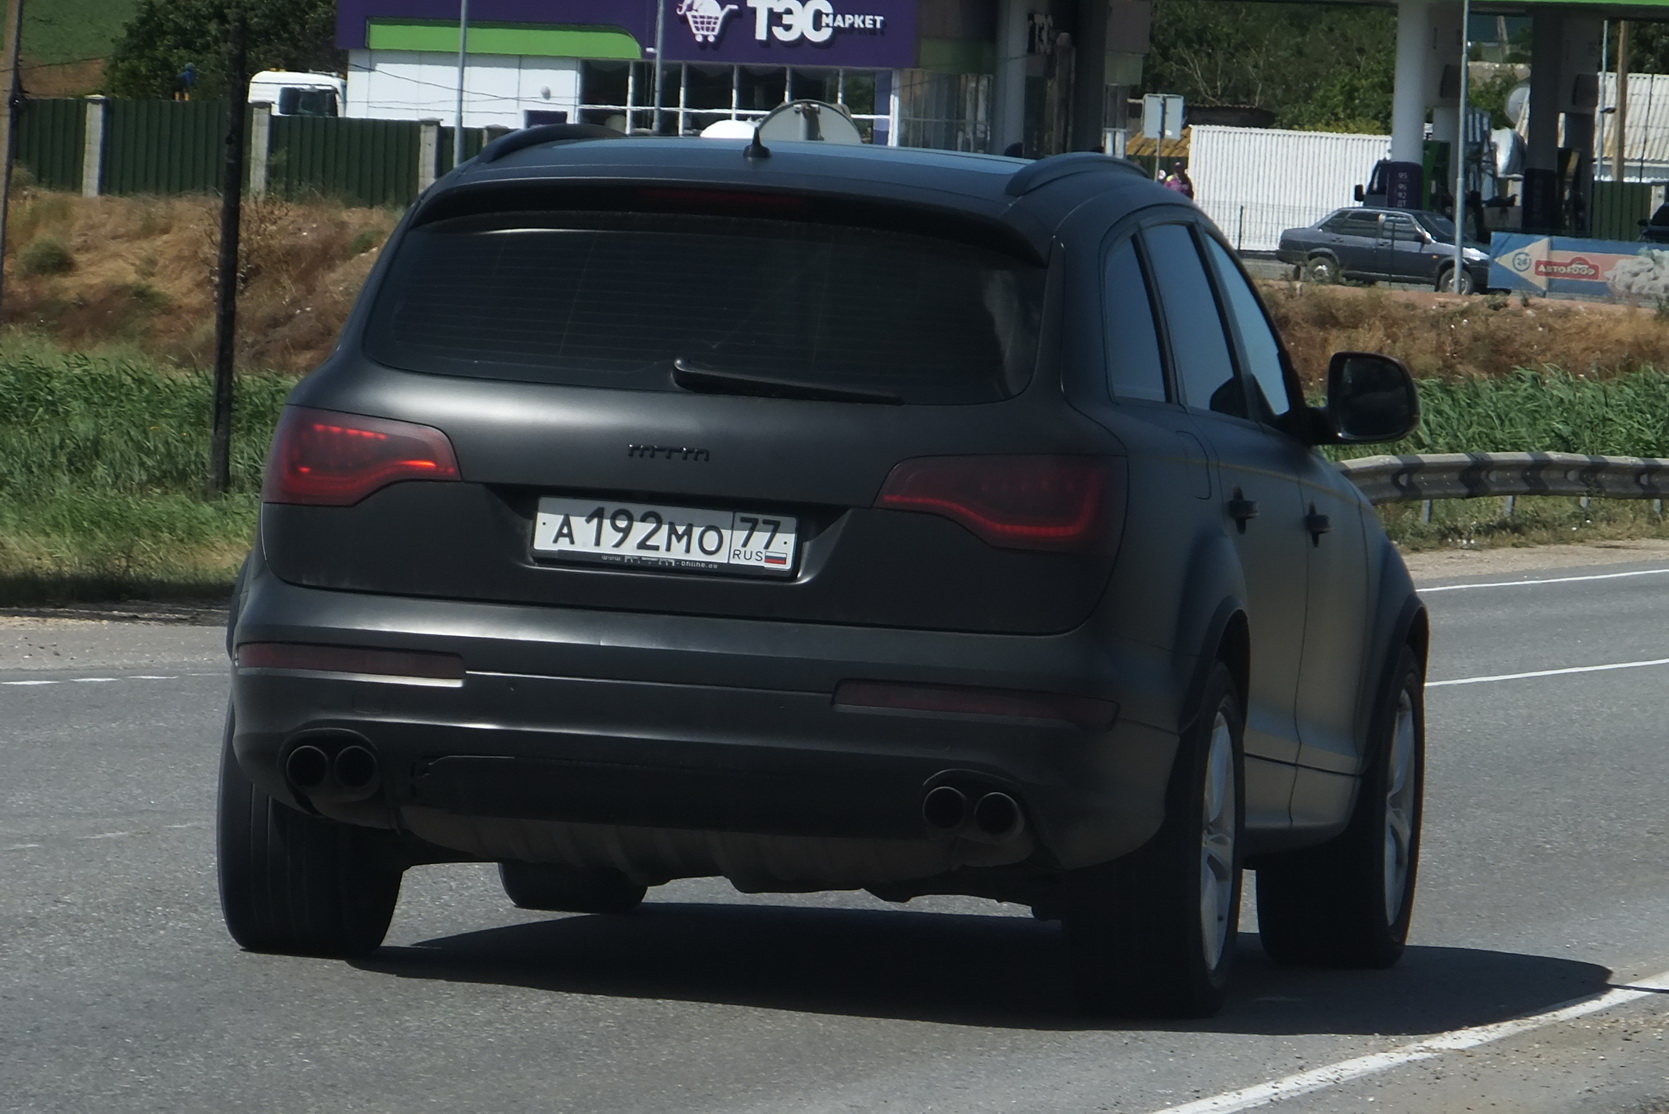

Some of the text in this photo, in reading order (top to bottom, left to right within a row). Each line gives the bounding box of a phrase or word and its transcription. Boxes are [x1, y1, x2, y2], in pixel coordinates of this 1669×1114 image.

[747, 0, 834, 43] ТЭС
[821, 14, 885, 29] МАРКЕТ
[739, 516, 781, 550] 77
[732, 550, 764, 562] RUS
